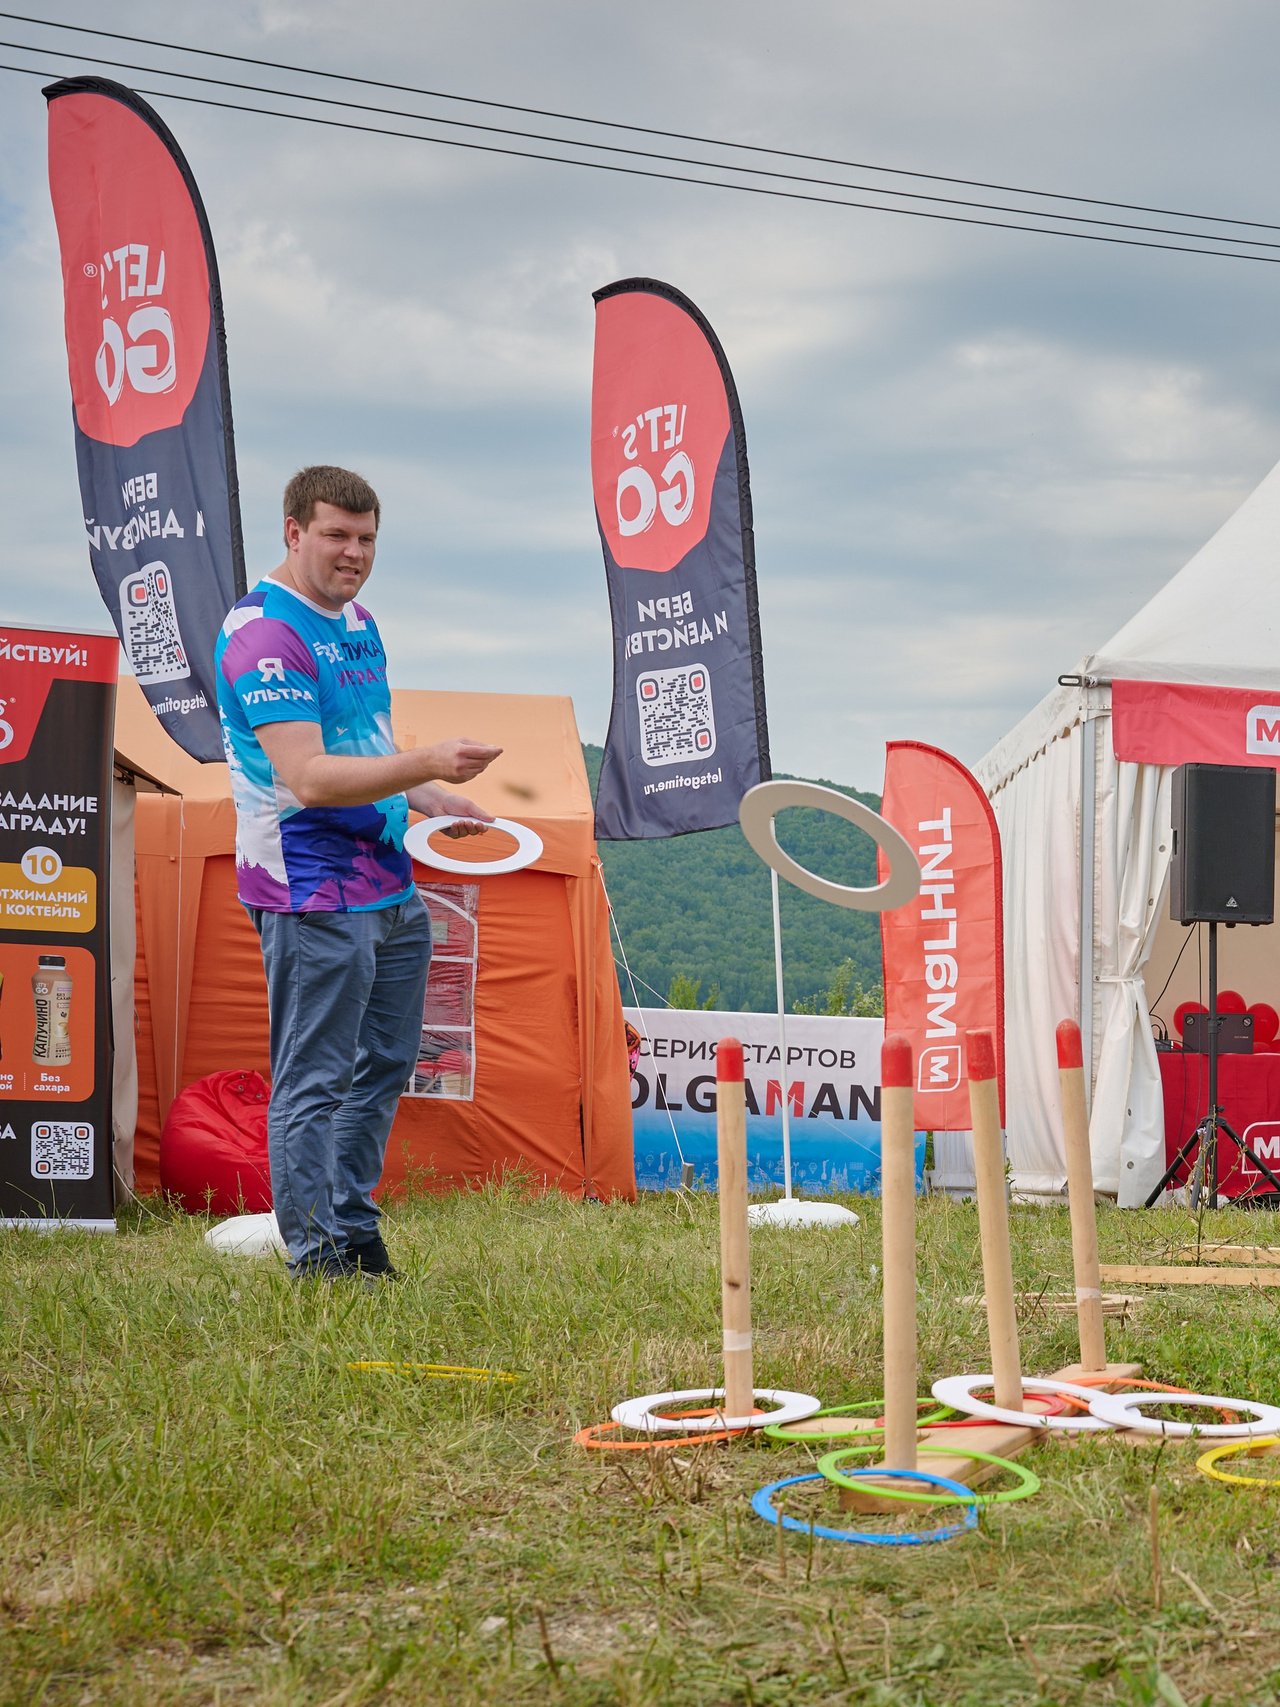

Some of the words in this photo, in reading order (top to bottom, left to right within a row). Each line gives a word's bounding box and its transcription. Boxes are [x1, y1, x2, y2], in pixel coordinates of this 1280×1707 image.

[257, 658, 286, 682] Я
[242, 688, 315, 706] УЛЬТРА
[0, 790, 98, 813] АДАНИЕ
[27, 854, 58, 876] 10
[0, 889, 88, 904] ТЖИМАНИЙ
[6, 904, 81, 919] КОКТЕЙЛЬ
[34, 999, 48, 1058] КАПУЧИНО
[40, 1073, 61, 1082] Без
[33, 1084, 71, 1094] сахара
